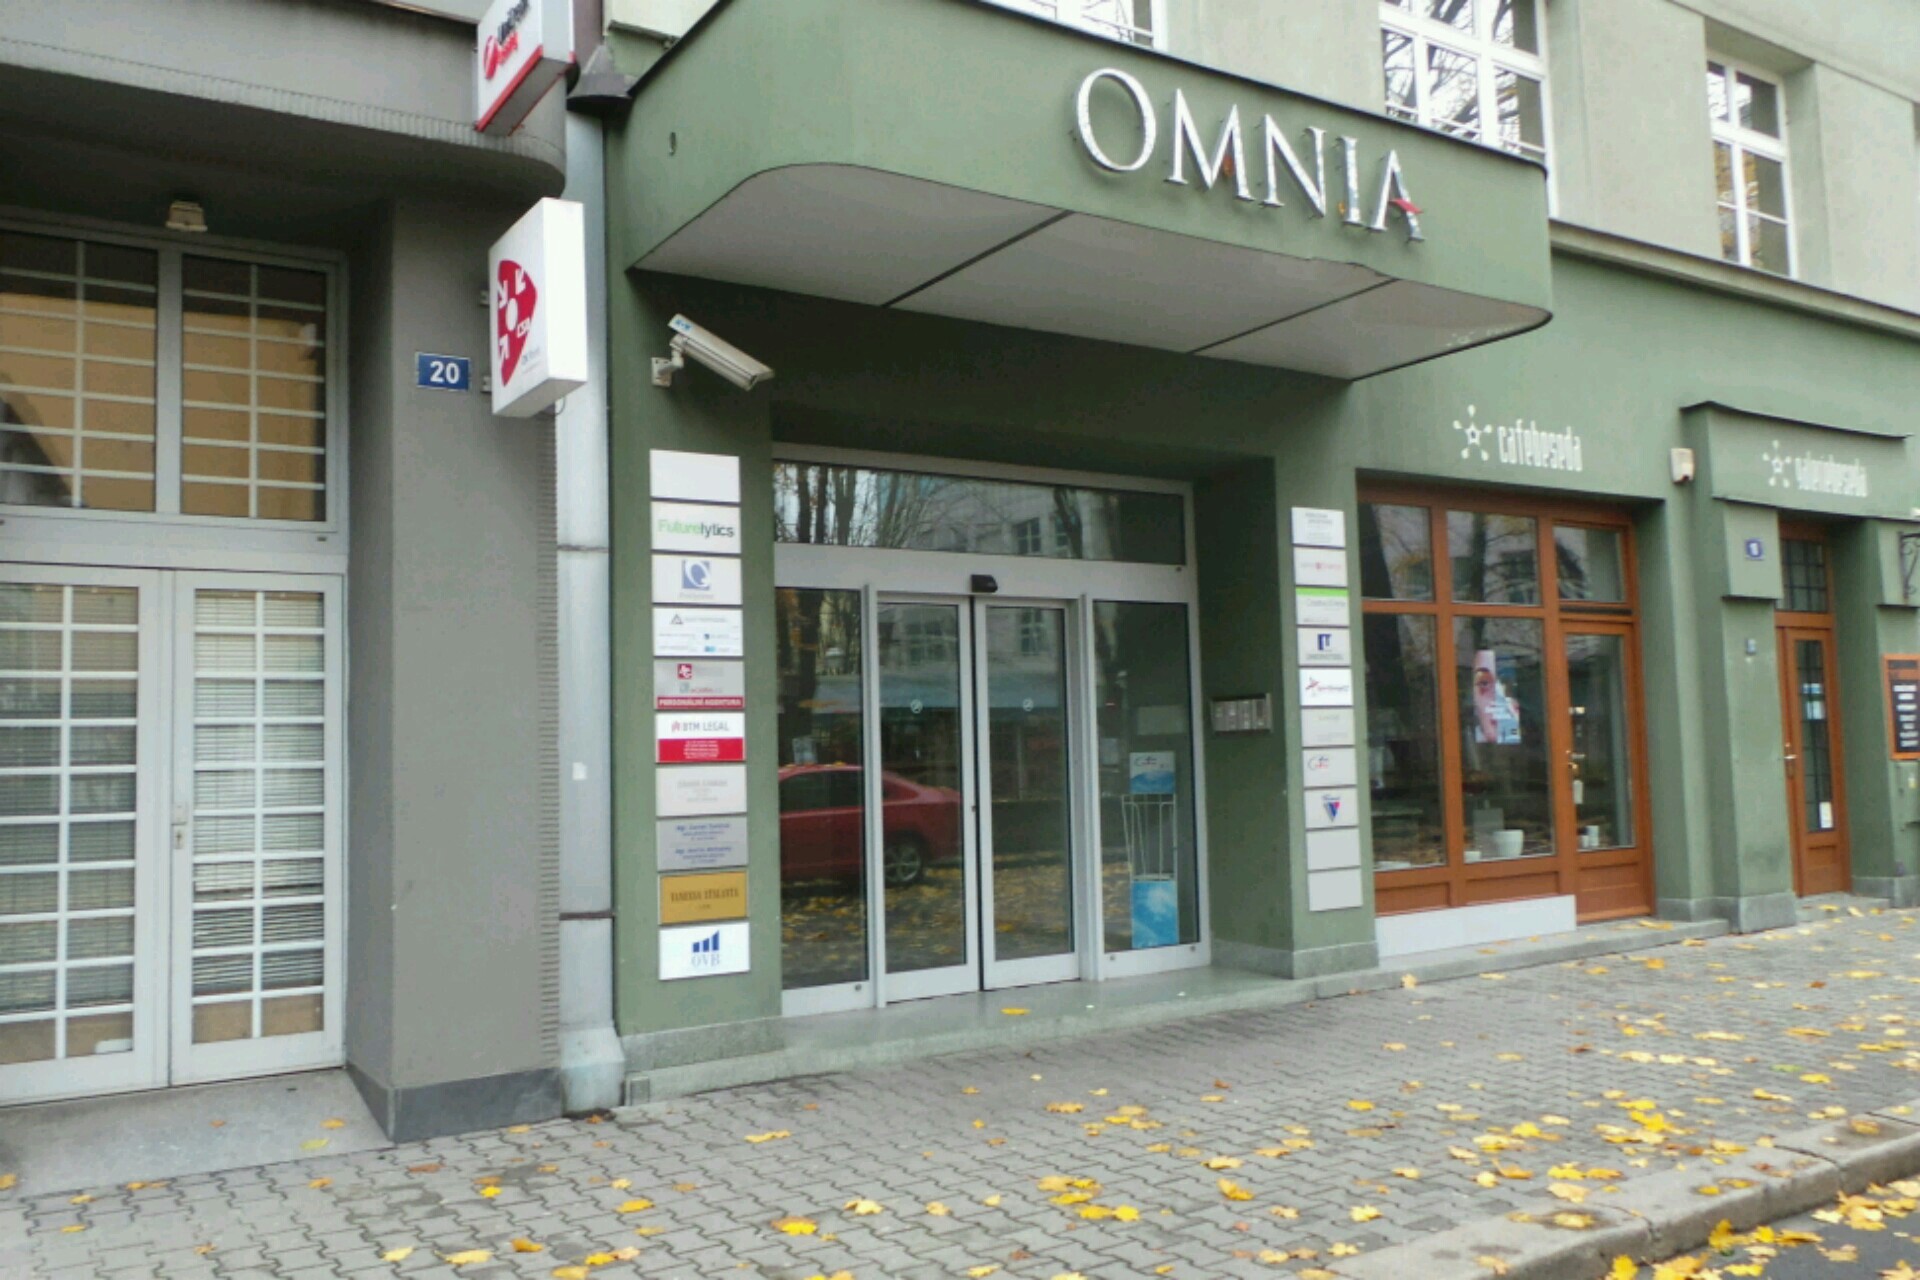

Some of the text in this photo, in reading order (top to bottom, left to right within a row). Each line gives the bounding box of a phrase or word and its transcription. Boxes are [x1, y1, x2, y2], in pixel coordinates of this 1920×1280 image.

[1076, 67, 1425, 242] OMNIA
[429, 360, 460, 384] 20
[657, 518, 735, 539] Futurelytics
[702, 720, 730, 732] LEGAL
